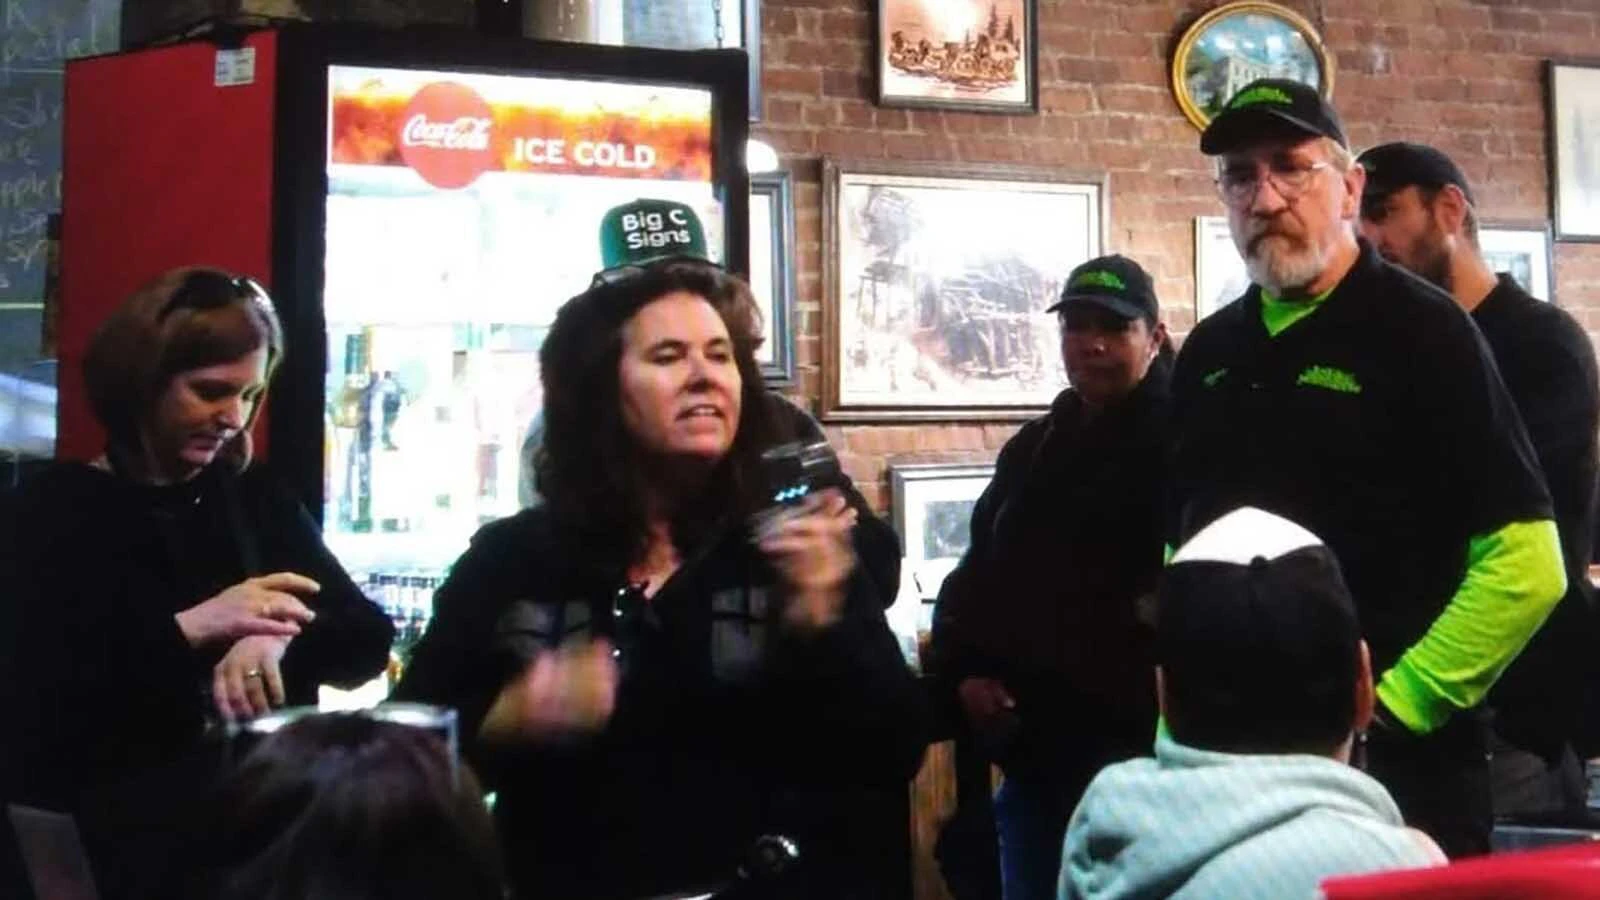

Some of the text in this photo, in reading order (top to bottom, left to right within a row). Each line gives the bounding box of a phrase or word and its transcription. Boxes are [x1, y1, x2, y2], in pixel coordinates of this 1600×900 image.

[513, 138, 657, 169] ICE COLD
[622, 208, 687, 232] Big C
[627, 229, 692, 249] Signs
